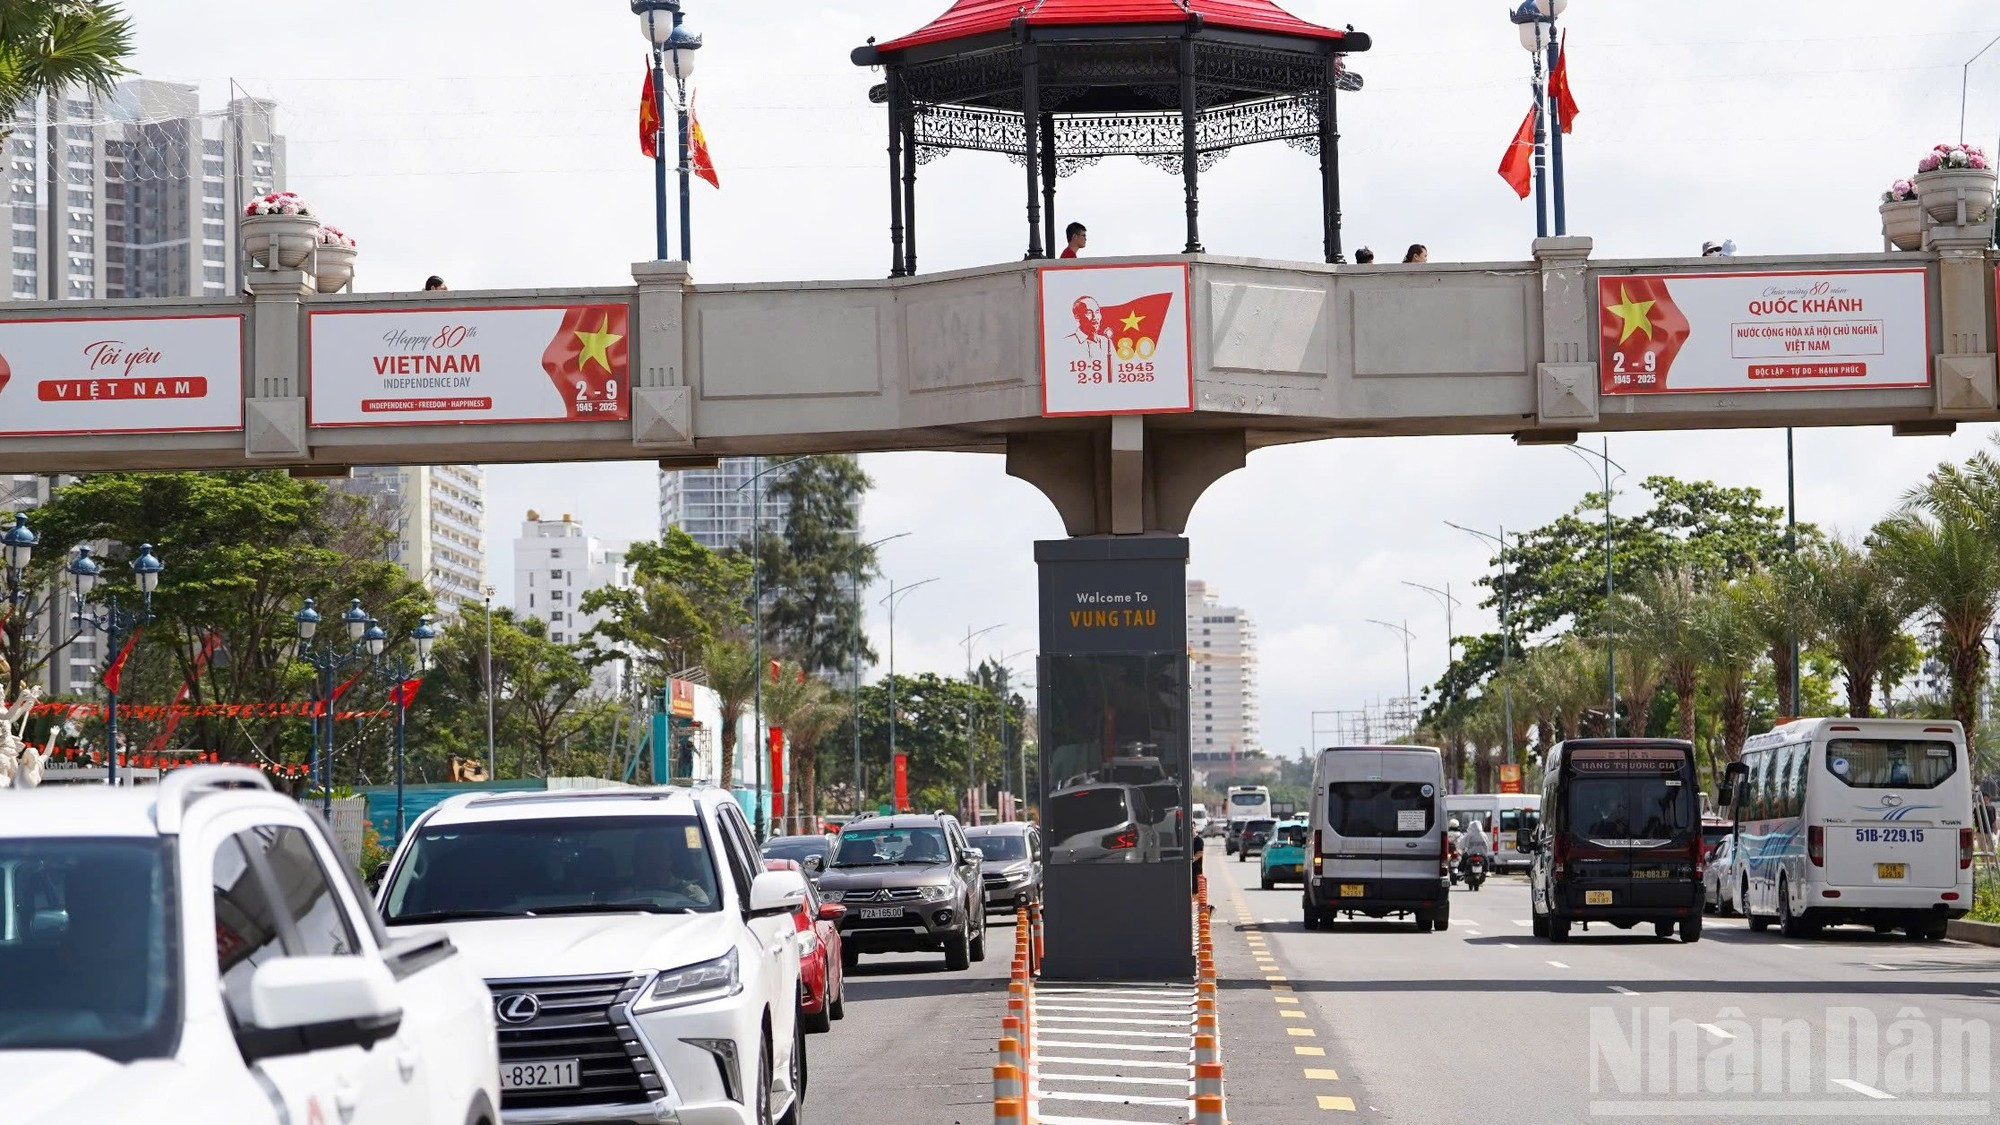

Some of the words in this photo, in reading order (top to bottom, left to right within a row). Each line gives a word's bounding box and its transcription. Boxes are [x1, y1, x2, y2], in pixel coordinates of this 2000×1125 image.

[1808, 281, 1830, 297] 80
[1748, 295, 1798, 316] QUỐC
[1802, 295, 1863, 313] KHÁNH
[1736, 326, 1760, 338] NƯỚC
[1761, 326, 1784, 340] CỘNG
[1785, 325, 1802, 337] HÒA
[1804, 325, 1815, 337] XÃ
[1816, 324, 1832, 339] HỘI
[1833, 323, 1850, 336] CHỦ
[1851, 323, 1878, 335] NGHĨA
[382, 328, 432, 351] Happy
[1784, 339, 1806, 354] VIỆT
[1808, 340, 1830, 352] NAM
[1115, 335, 1157, 361] 80
[83, 340, 127, 371] Tôi
[123, 346, 163, 377] yêu
[372, 354, 481, 375] VIETNAM
[1069, 359, 1103, 373] 19-8
[1612, 351, 1625, 373] 2
[1643, 350, 1656, 372] 9
[1117, 361, 1155, 373] 1945
[1802, 367, 1813, 375] DO
[1840, 365, 1860, 374] PHÚC
[383, 377, 452, 390] INDEPENDENCE
[453, 376, 471, 388] DAY
[1077, 372, 1103, 384] 2-9
[1117, 372, 1155, 384] 2025
[1613, 375, 1631, 384] 1945
[1637, 374, 1656, 384] 2025
[55, 380, 119, 401] VIỆT
[133, 381, 190, 397] NAM
[575, 380, 588, 401] 2
[605, 379, 618, 400] 9
[369, 401, 414, 410] INDEPENDENCE
[418, 401, 447, 409] FREEDOM
[450, 399, 485, 408] HAPPINESS
[575, 402, 593, 412] 1945
[598, 401, 618, 411] 2025
[1076, 591, 1132, 604] Welcome
[1134, 591, 1148, 602] To
[1069, 610, 1119, 628] VUNG
[1123, 609, 1157, 627] TAU
[1658, 762, 1676, 770] GIA
[1855, 828, 1925, 843] 51B-229.15
[862, 908, 902, 918] 72A-165.00
[499, 1063, 574, 1088] -832.11
